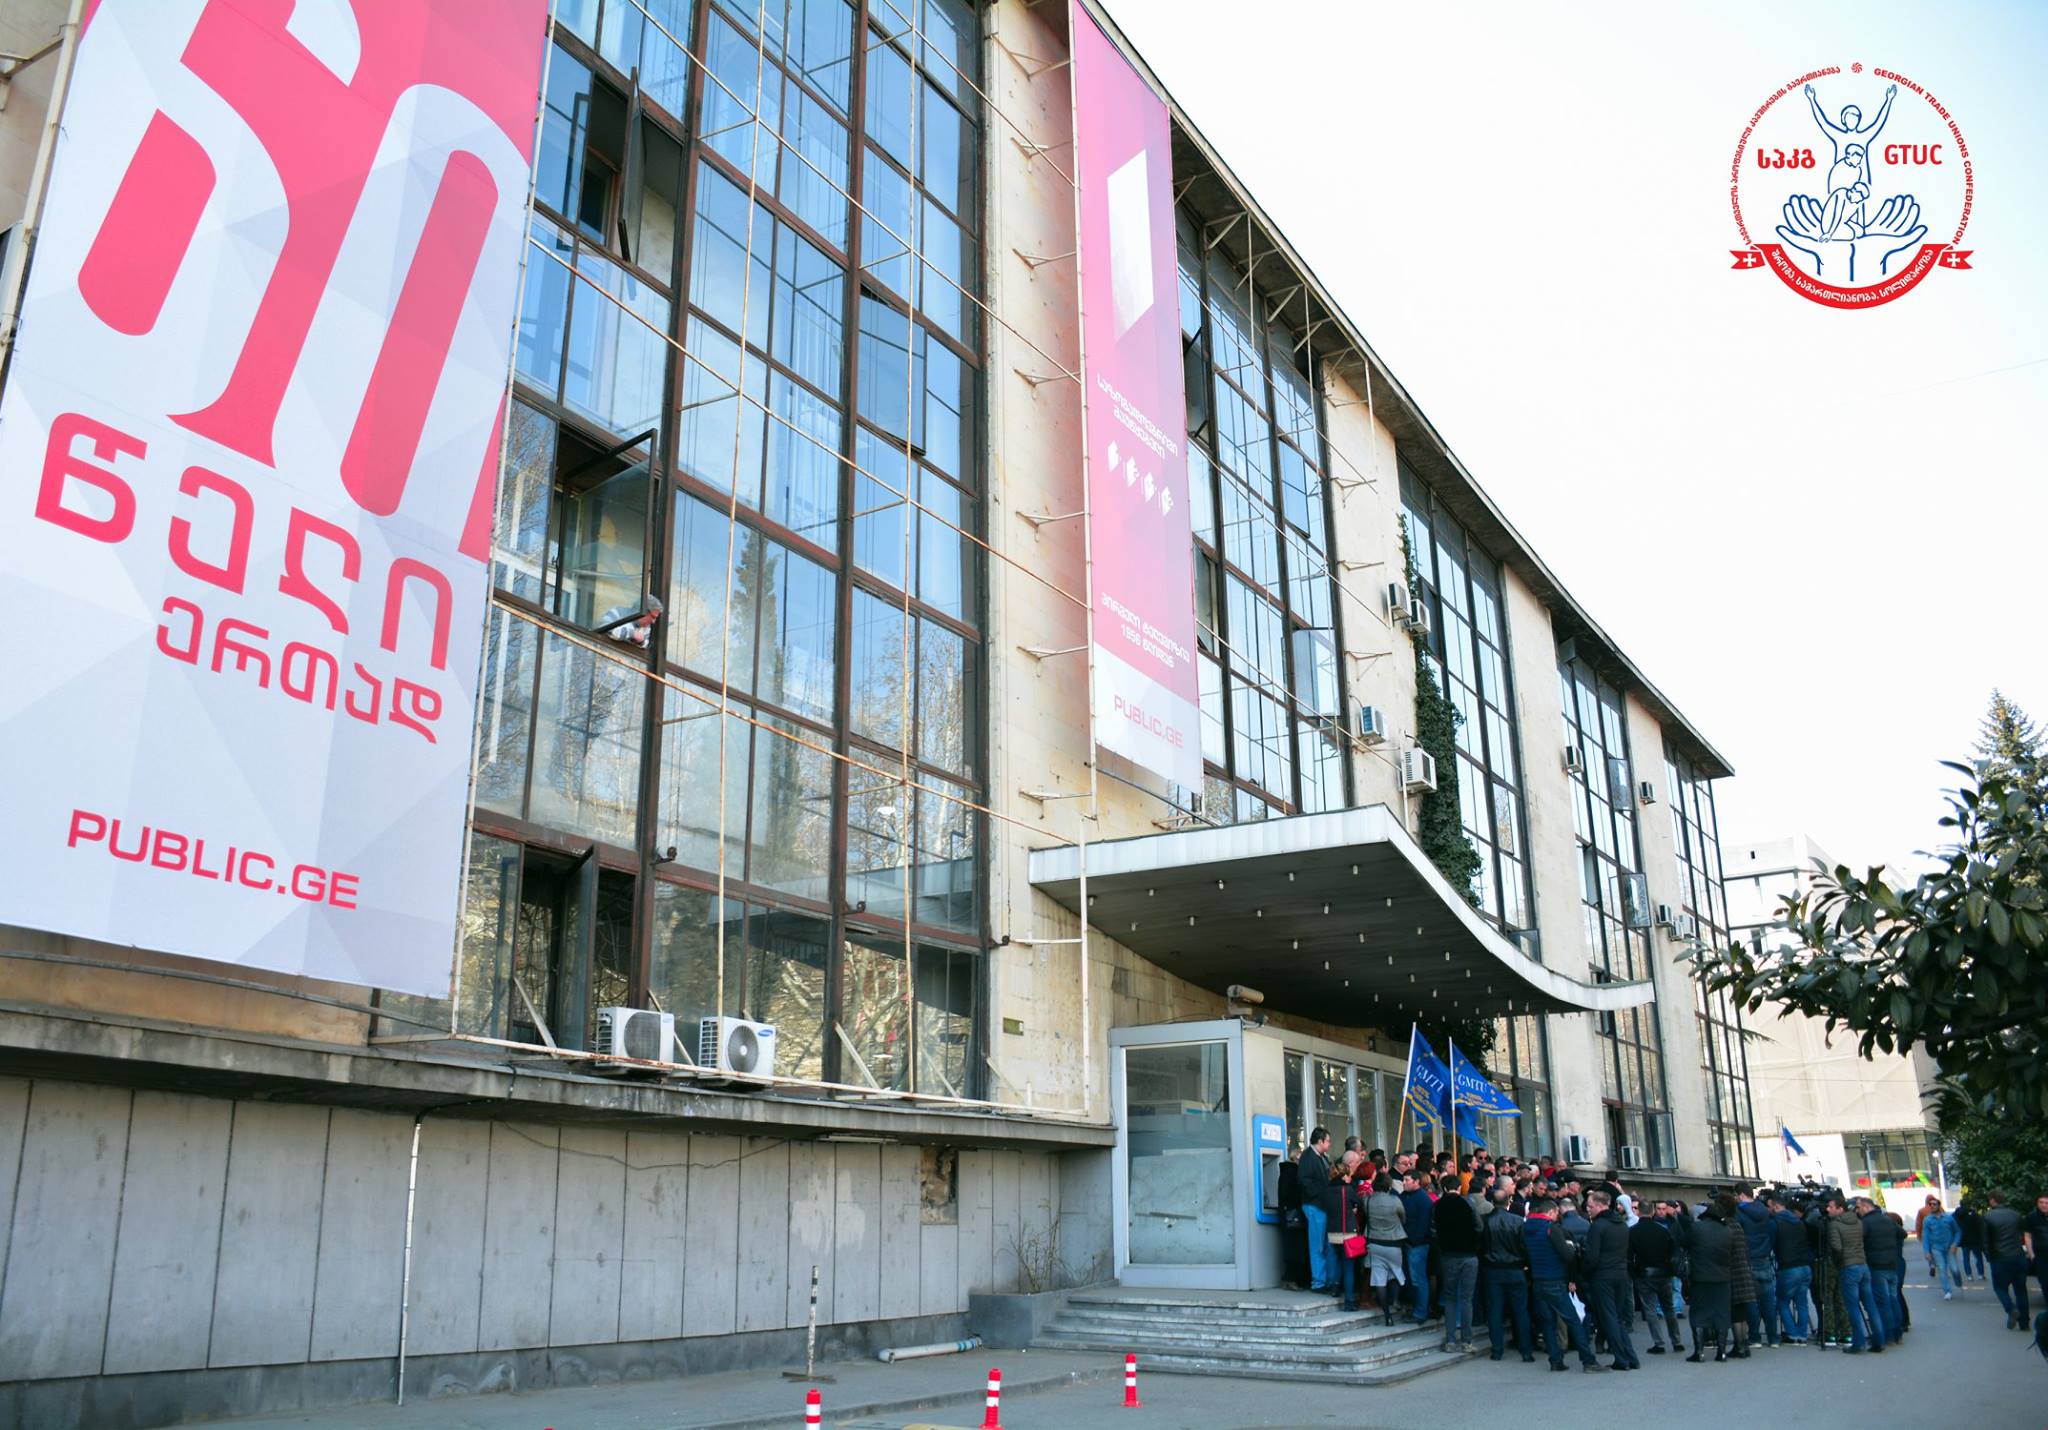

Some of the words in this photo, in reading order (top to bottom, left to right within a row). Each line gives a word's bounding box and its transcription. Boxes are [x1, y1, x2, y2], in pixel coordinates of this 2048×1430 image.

[35, 412, 454, 671] წელი
[155, 596, 443, 745] ერთად
[1113, 694, 1184, 749] PUBLIC.GE
[67, 809, 361, 910] PUBLIC.GE
[1457, 1073, 1489, 1093] GMTU
